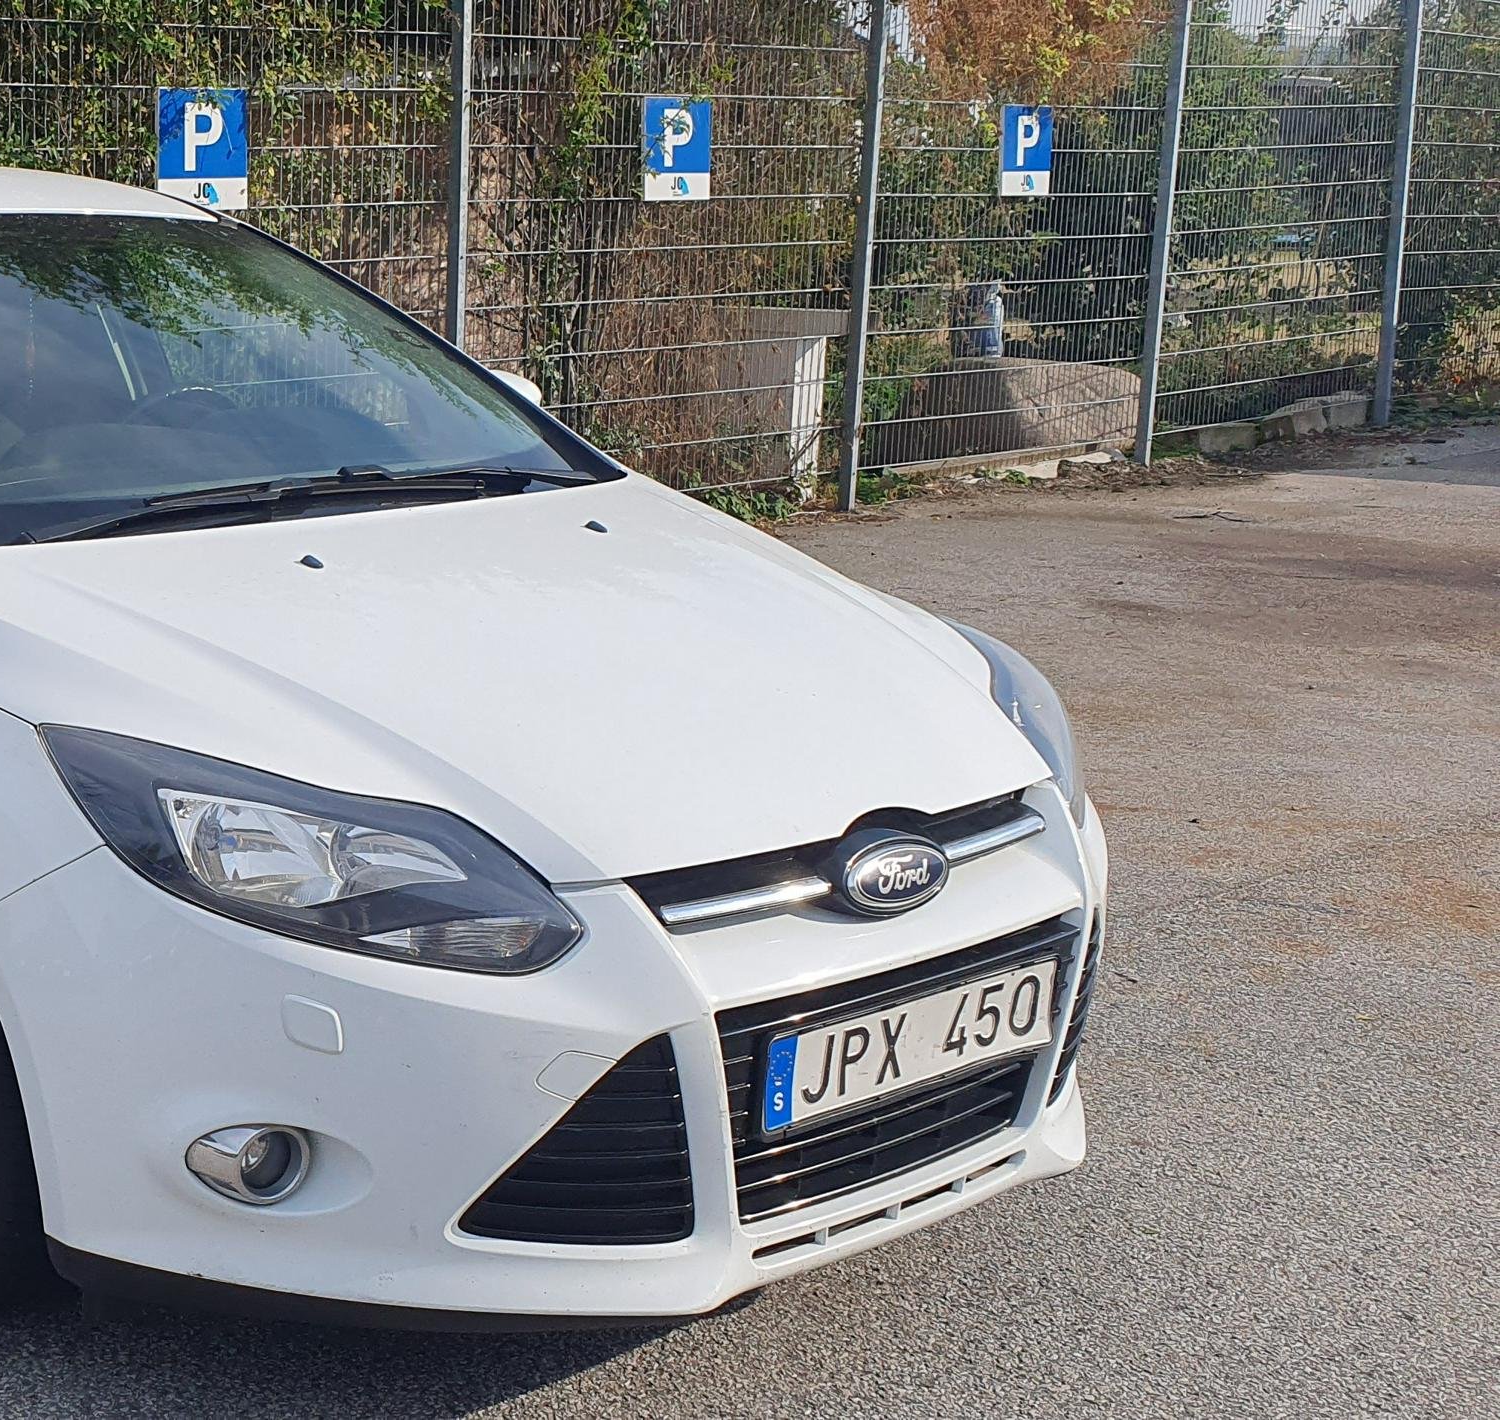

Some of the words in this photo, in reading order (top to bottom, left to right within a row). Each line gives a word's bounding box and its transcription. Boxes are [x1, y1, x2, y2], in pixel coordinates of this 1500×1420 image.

[184, 102, 223, 172] P
[664, 108, 694, 168] P
[1016, 115, 1040, 167] P
[193, 182, 211, 199] JC
[875, 853, 931, 895] Ford
[800, 1012, 907, 1104] JPX
[941, 974, 1041, 1057] 450
[773, 1091, 784, 1112] S
